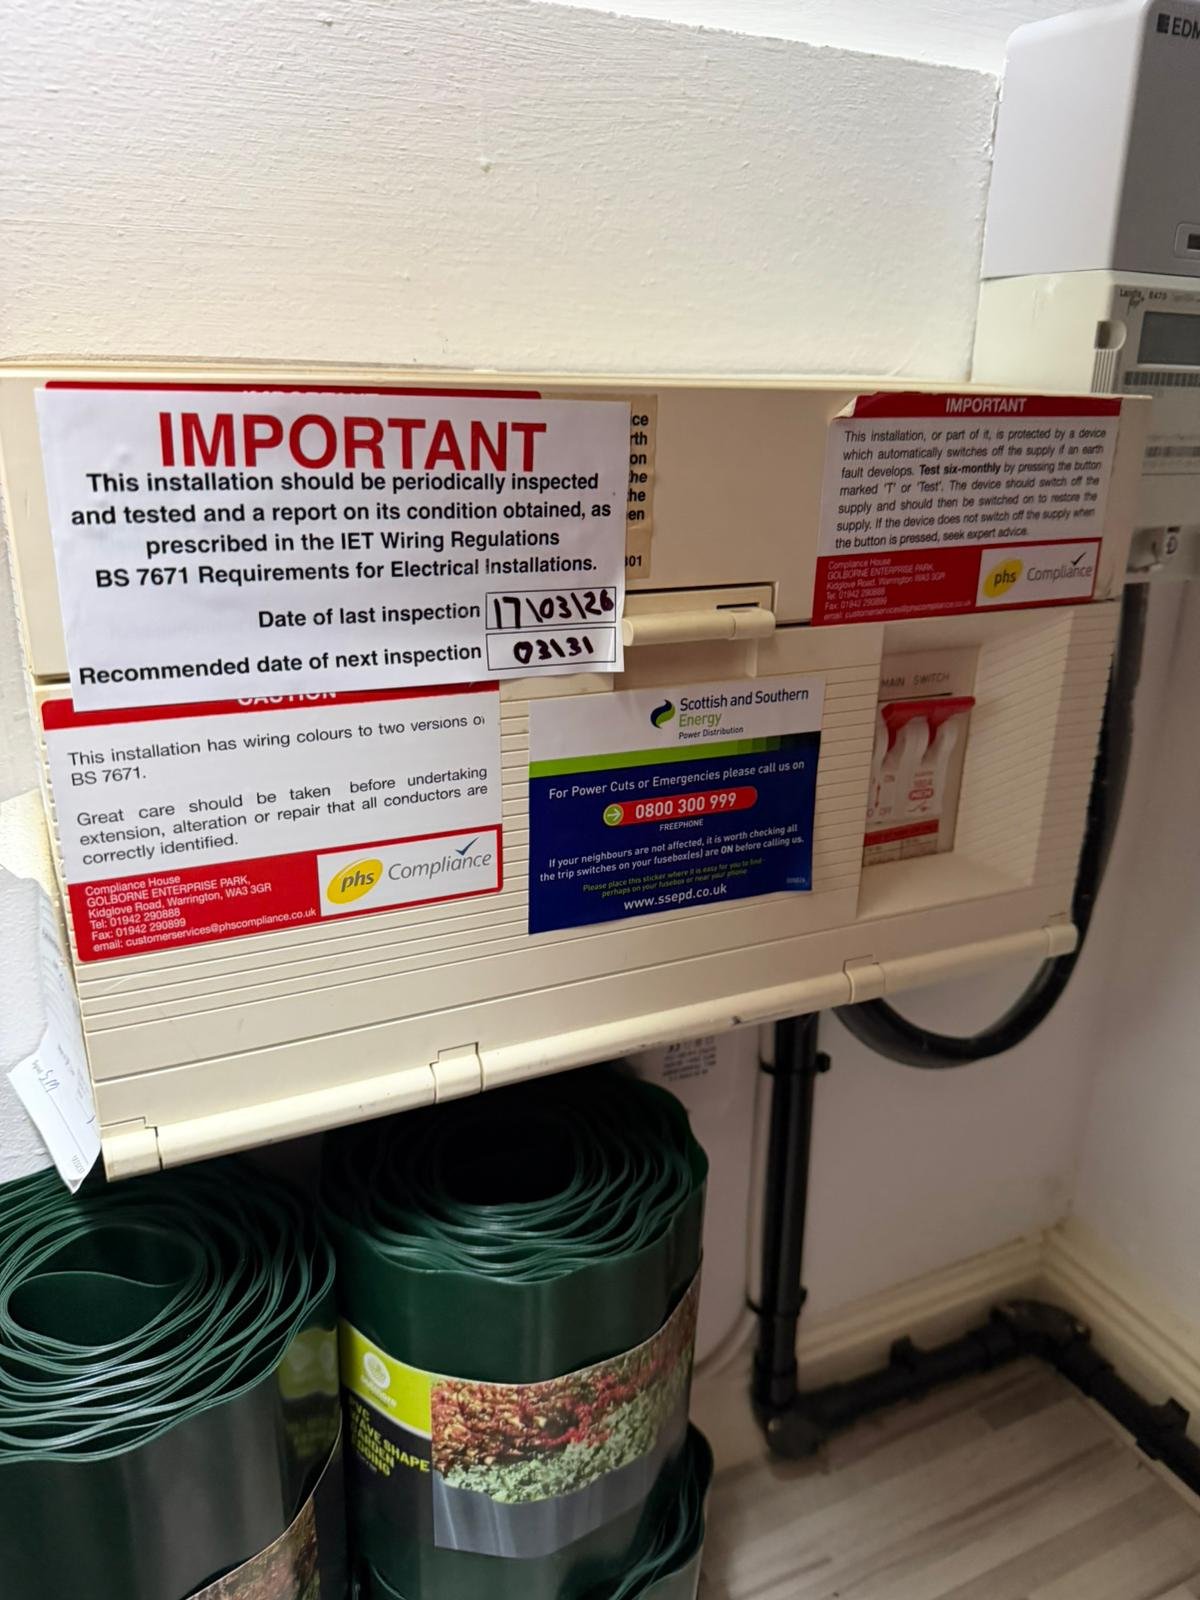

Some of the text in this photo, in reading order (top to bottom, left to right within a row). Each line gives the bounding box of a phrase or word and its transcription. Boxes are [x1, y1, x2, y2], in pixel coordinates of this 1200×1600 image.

[945, 397, 1027, 413] IMPORTANT
[159, 411, 547, 472] IMPORTANT
[844, 428, 1107, 443] This installation, or part of it, is protected by a device
[85, 471, 599, 495] This installation should be periodically inspected
[628, 489, 646, 502] he
[71, 500, 611, 526] and tested and a report on its condition obtained, as
[146, 529, 560, 560] prescribed in the IET Wiring Regulations
[95, 555, 597, 588] BS 7671 Requirements for Electrical Installations.
[993, 568, 1017, 588] phs
[1026, 564, 1093, 583] Compliance
[258, 602, 481, 628] Date of last inspection
[79, 644, 482, 685] Recommended date of next inspection
[679, 688, 809, 712] Scottish and Southern
[678, 712, 722, 728] Energy
[67, 750, 105, 766] This
[111, 741, 201, 763] installation
[207, 739, 237, 752] has
[242, 732, 291, 749] wiring
[296, 728, 353, 743] colours
[358, 725, 373, 737] to
[378, 723, 405, 735] two
[410, 717, 468, 732] versions
[678, 727, 744, 740] Power Distribution
[71, 766, 146, 787] BS 7671.
[549, 761, 805, 800] For Power Cuts or Emergencies please call us on
[76, 767, 488, 827] Great care should be taken before undertaking
[635, 792, 737, 819] 0800 300 999
[79, 785, 488, 846] extension, alteration or repair that all conductors are
[660, 819, 703, 831] FREEPHONE
[82, 832, 239, 865] correctly identified.
[540, 836, 804, 882] the trip switches on your fusebox(es) are ON before calling us.
[549, 824, 798, 869] If your neighbours are not affected, it is worth checking all
[388, 852, 492, 880] Compliance
[84, 876, 181, 897] Compliance House
[86, 874, 251, 908] GOLBORNE ENTERPRISE PARK,
[340, 870, 375, 893] phs
[88, 901, 133, 919] Kidglove
[166, 892, 223, 907] Warrington,
[250, 882, 272, 894] 3GR
[623, 883, 727, 910] www.ssepd.co.uk
[89, 908, 181, 930] Tel: 01942 290888
[91, 918, 186, 941] Fax: 01942 290899
[93, 907, 317, 952] email: customerservices@phscompliance.co.uk
